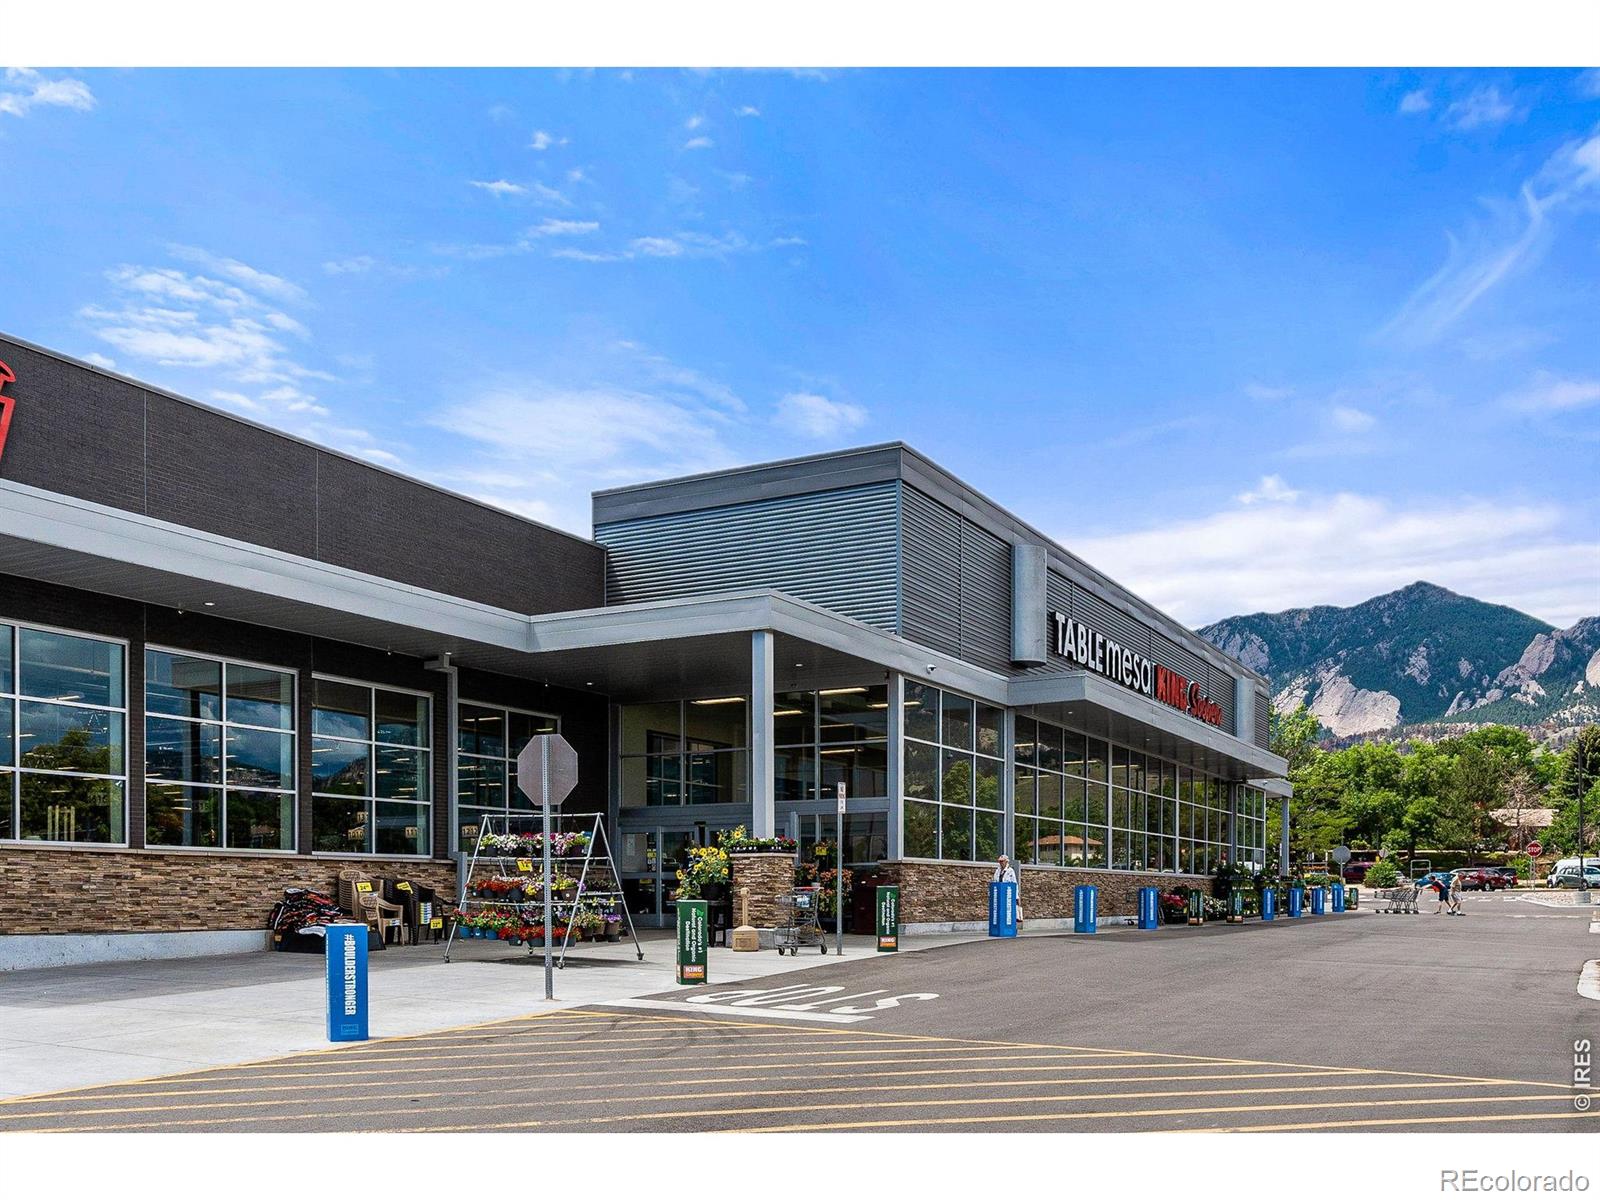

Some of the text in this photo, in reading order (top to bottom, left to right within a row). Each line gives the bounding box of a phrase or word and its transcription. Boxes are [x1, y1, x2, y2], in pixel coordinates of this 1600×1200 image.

[1055, 611, 1151, 694] TABLE mesa
[344, 933, 357, 1016] #BOULDERSTRONGER
